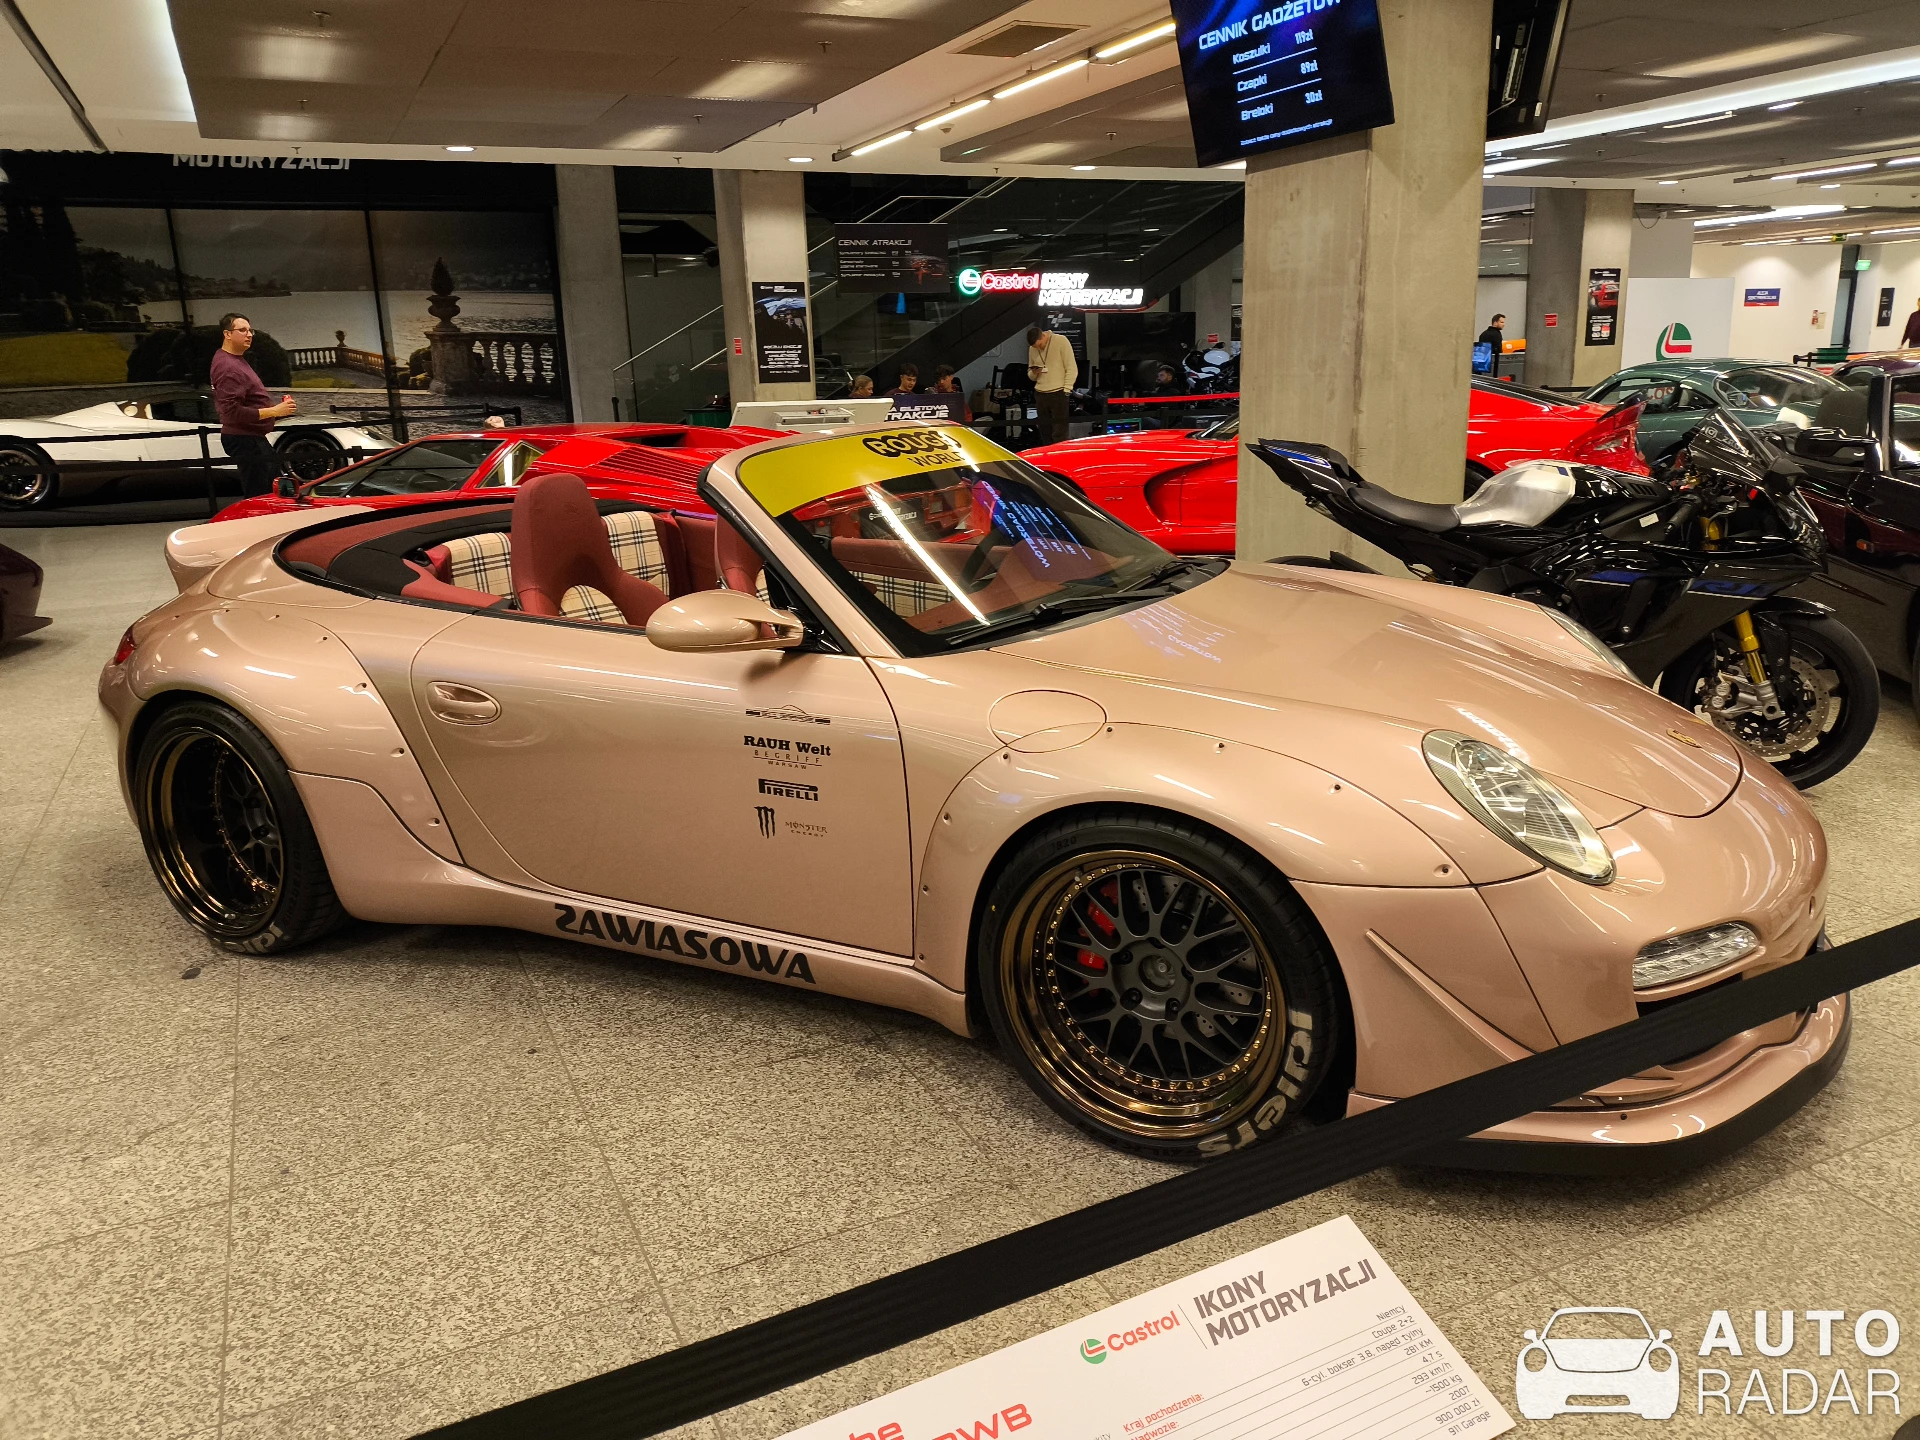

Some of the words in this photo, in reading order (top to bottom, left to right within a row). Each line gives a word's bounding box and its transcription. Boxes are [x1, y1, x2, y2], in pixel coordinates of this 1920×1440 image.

[1199, 18, 1248, 50] CENNIK
[1232, 43, 1271, 64] Koszulki
[1294, 29, 1314, 44] 119zł
[1237, 73, 1268, 92] Czapki
[1301, 60, 1318, 74] 89zł
[1241, 103, 1274, 121] Breloki
[1305, 90, 1323, 104] 30zł
[981, 272, 1040, 292] Castrol
[744, 735, 791, 751] RAUH
[795, 741, 831, 756] Welt
[754, 749, 820, 764] BEGRIFF
[767, 760, 807, 770] WARSAW
[758, 778, 819, 801] PIRELLI
[785, 821, 828, 833] MONSTER
[1193, 1270, 1267, 1319] IKONY
[1205, 1258, 1377, 1346] MOTORYZACJI
[1376, 1305, 1406, 1321] Niemcy
[1107, 1310, 1180, 1352] Castrol
[1372, 1323, 1397, 1340] Coupe
[1398, 1315, 1416, 1328] 2+2
[1301, 1375, 1328, 1387] 6-cyl.
[1328, 1356, 1356, 1376] bokser
[1357, 1350, 1376, 1362] 3.8,
[1401, 1327, 1424, 1343] tylny
[1404, 1347, 1420, 1356] 281
[1419, 1338, 1433, 1350] KM
[1436, 1351, 1443, 1359] s
[1412, 1372, 1430, 1385] 293
[1429, 1361, 1453, 1376] km/h
[1425, 1378, 1451, 1394] ~1500
[1450, 1373, 1464, 1384] kg
[1448, 1385, 1471, 1401] 2007
[1122, 1417, 1145, 1434] Kraj
[1144, 1392, 1205, 1424] pochodzenia:
[1435, 1412, 1454, 1426] 900
[1453, 1402, 1472, 1416] 000
[1471, 1397, 1482, 1407] zł
[1448, 1424, 1462, 1436] 911
[1461, 1409, 1492, 1428] Garage
